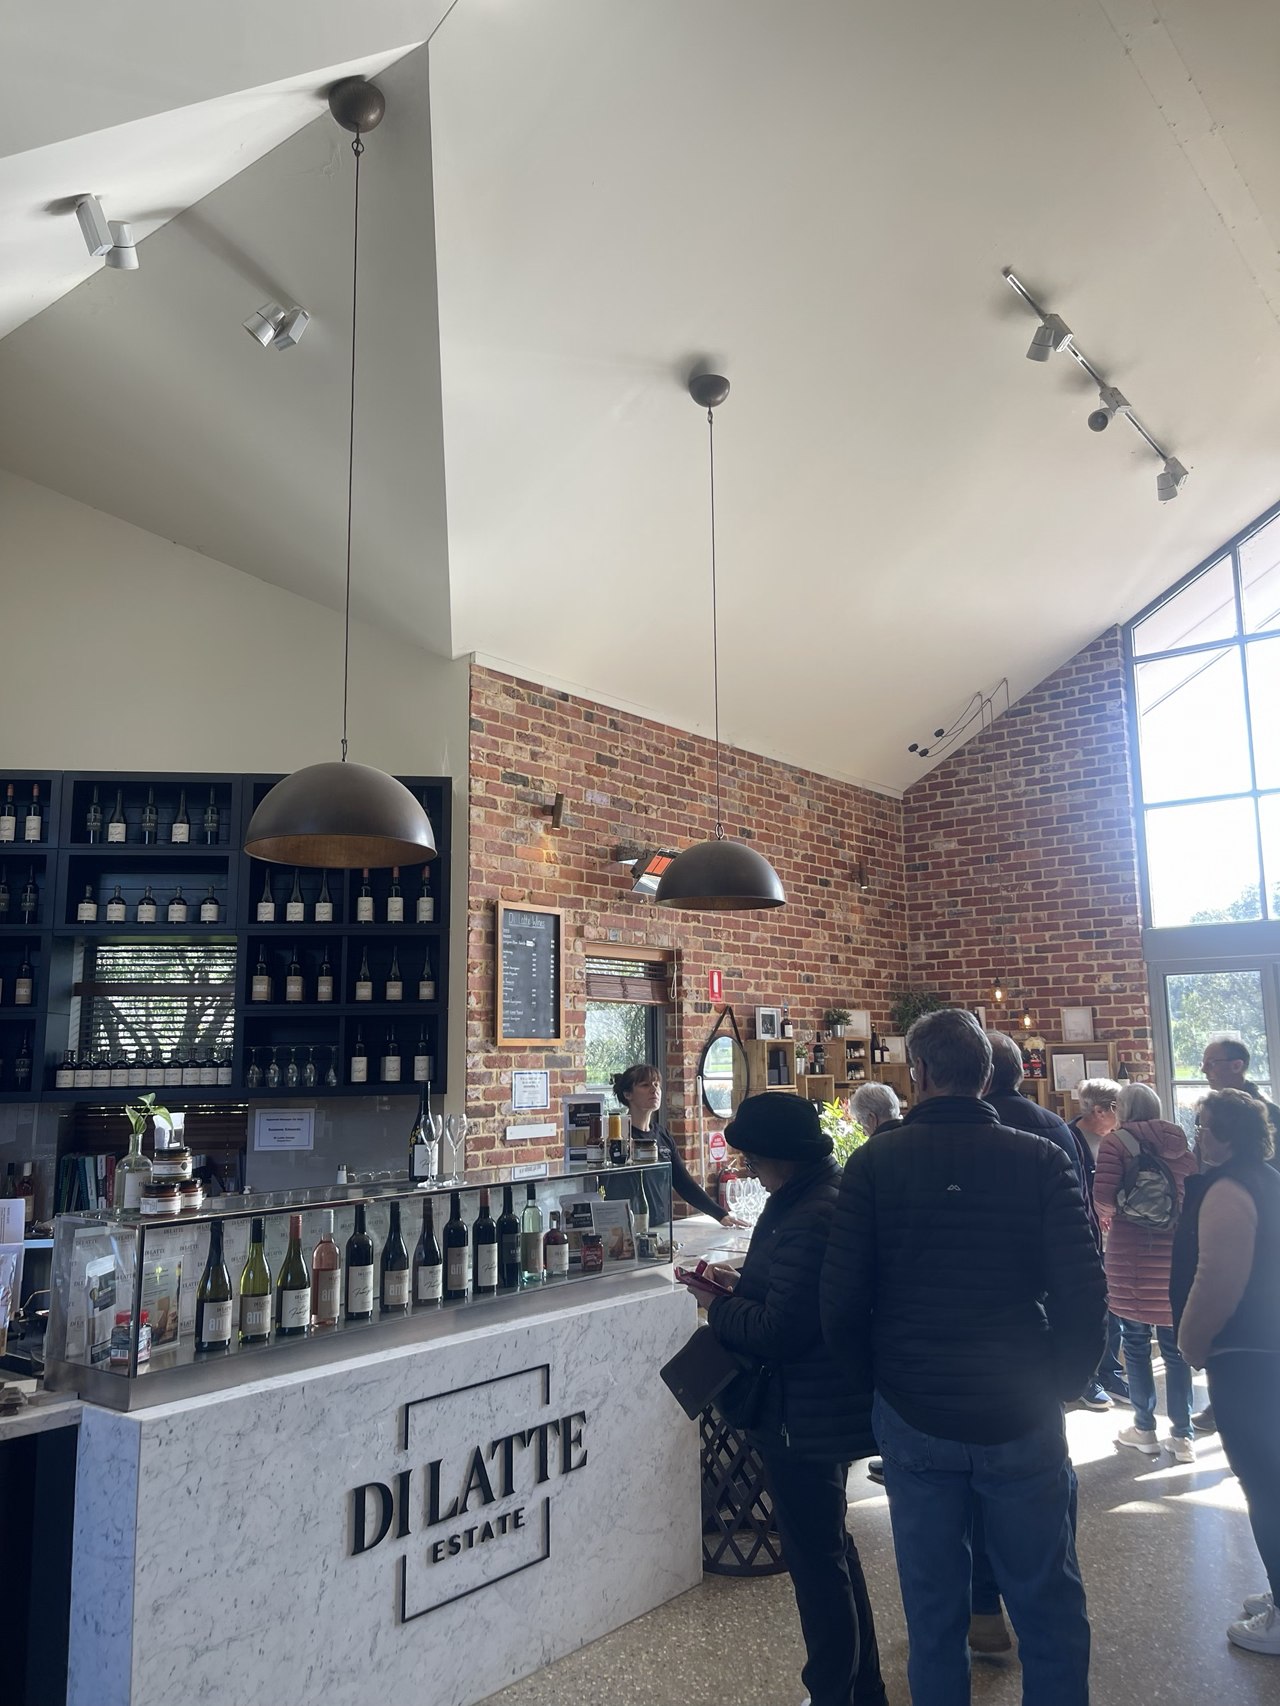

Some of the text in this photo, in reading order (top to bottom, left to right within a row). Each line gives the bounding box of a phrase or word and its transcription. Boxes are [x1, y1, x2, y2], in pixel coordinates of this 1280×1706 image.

[518, 913, 531, 926] Latte
[532, 915, 546, 927] Wines
[351, 1410, 588, 1556] DI LATTE
[432, 1507, 526, 1564] ESTATE
